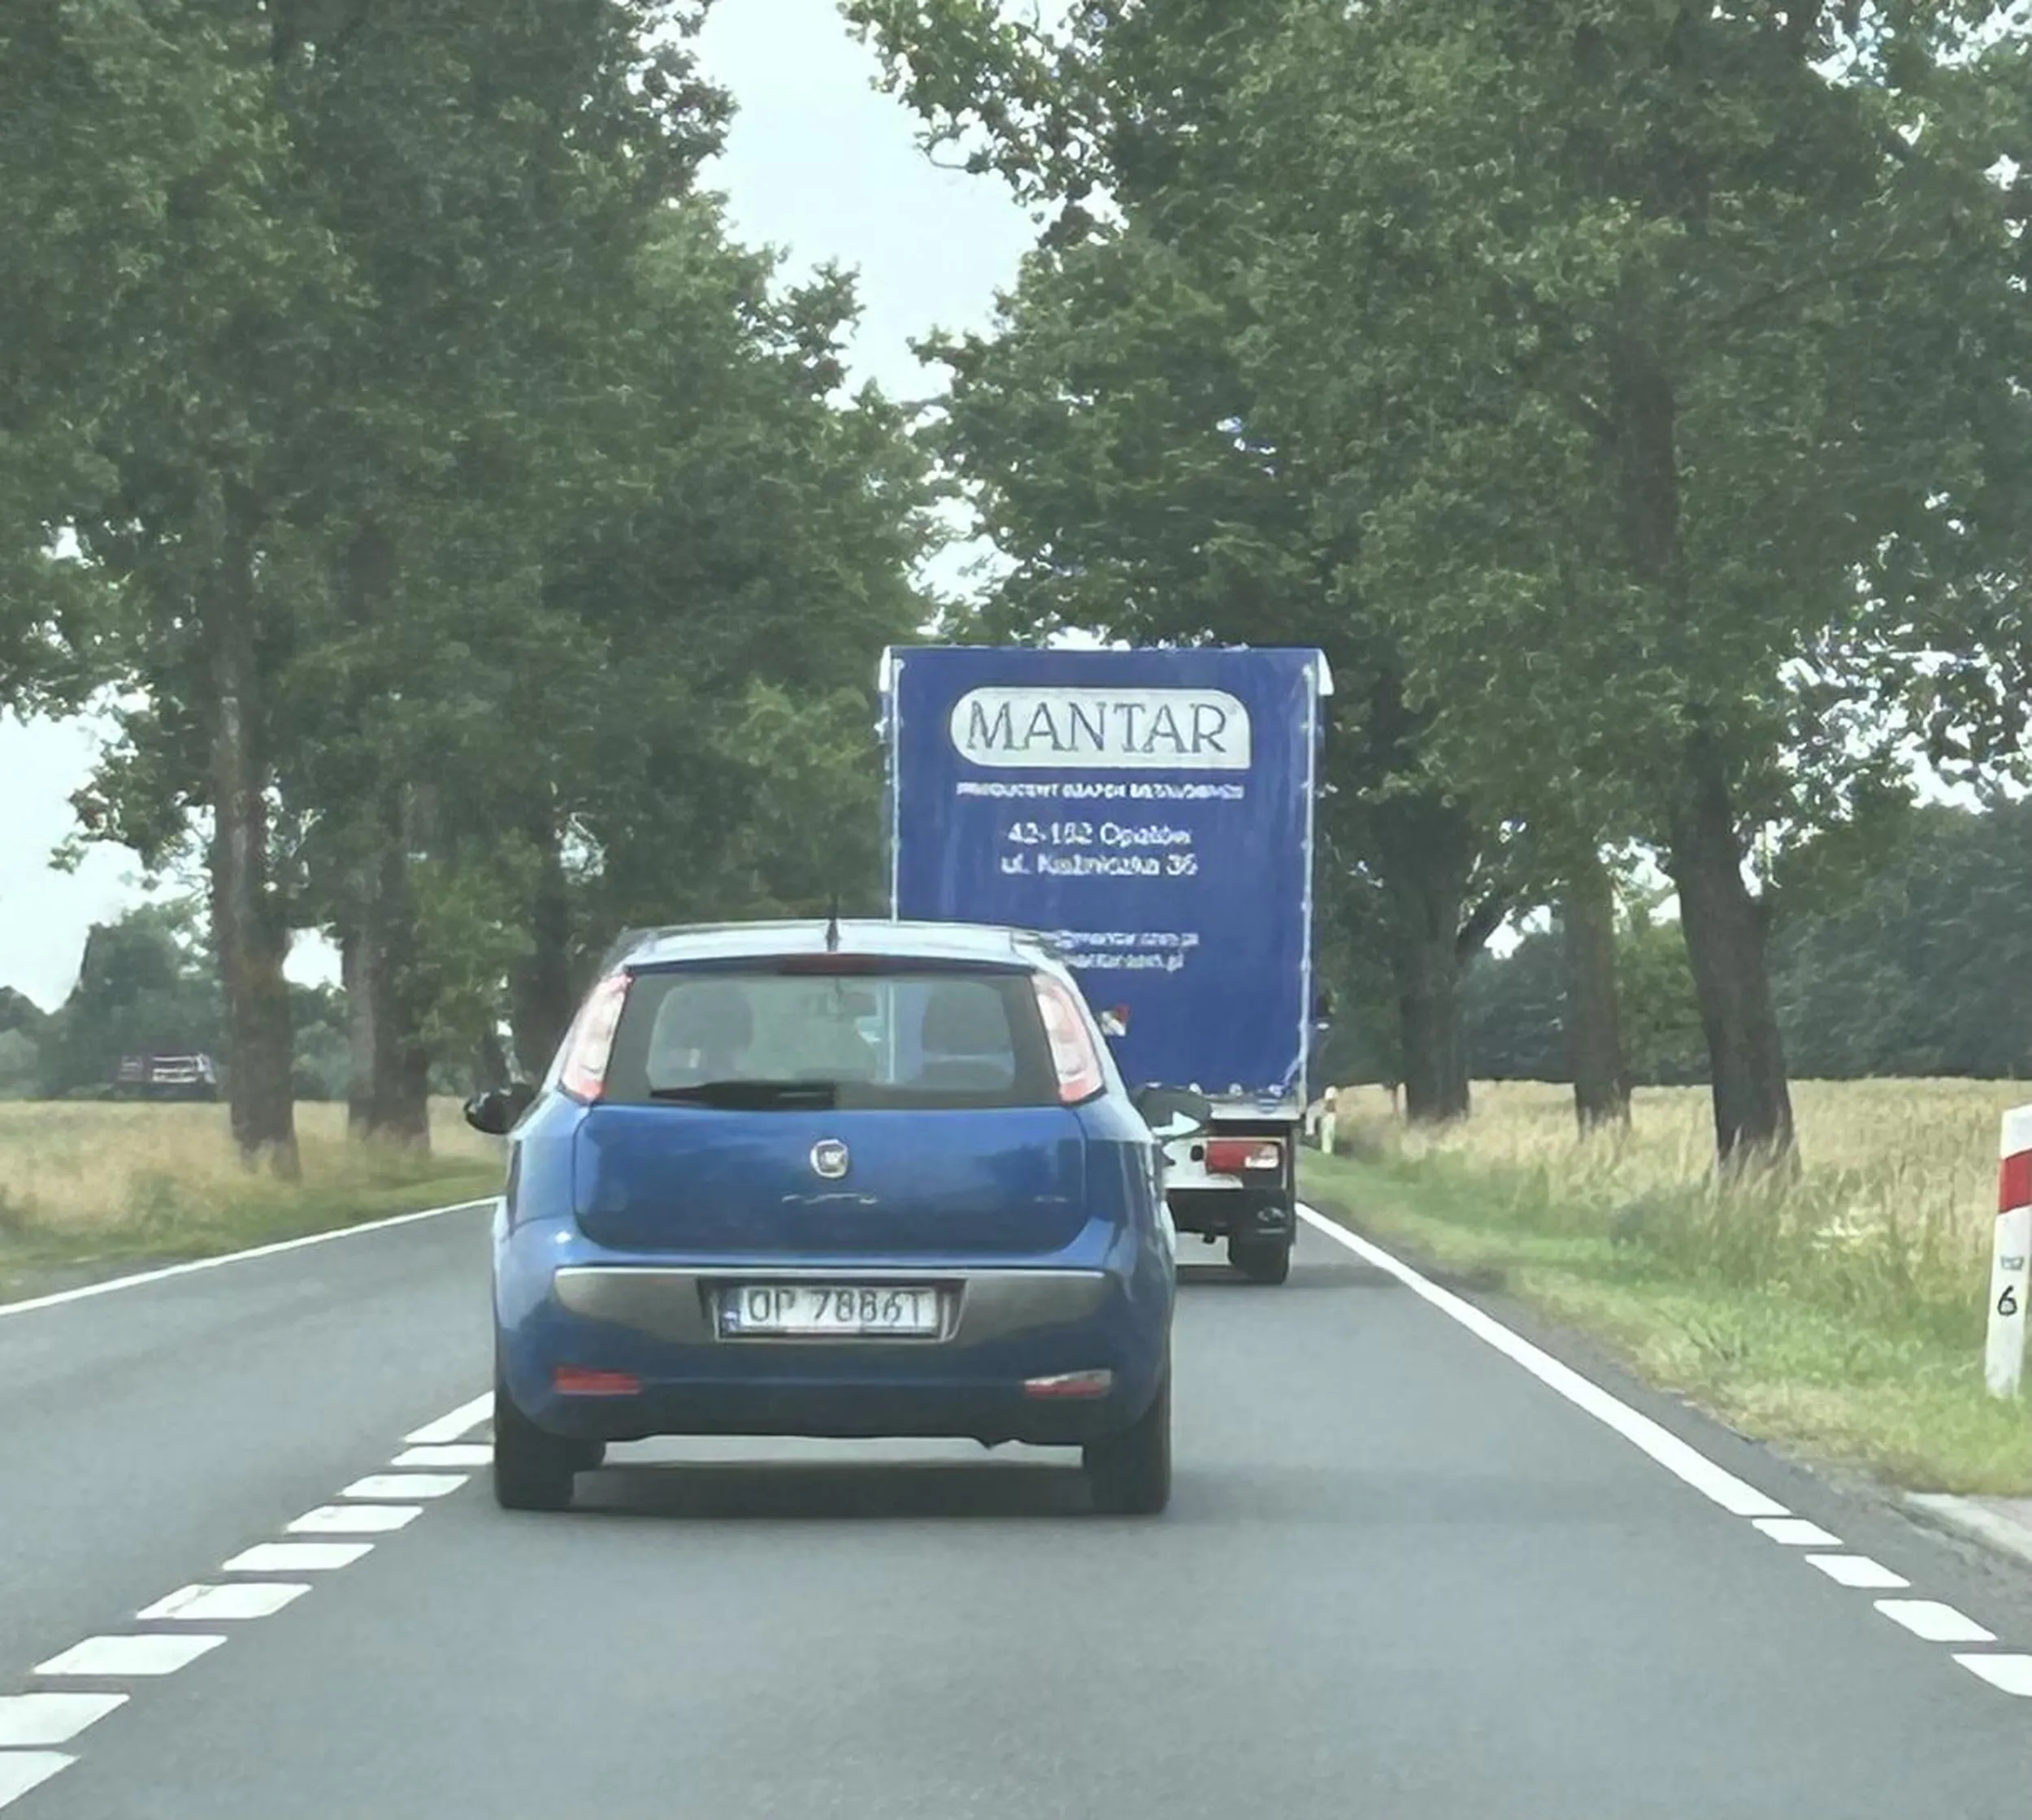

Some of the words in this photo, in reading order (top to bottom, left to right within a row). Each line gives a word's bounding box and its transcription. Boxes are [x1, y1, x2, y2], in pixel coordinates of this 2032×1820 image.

[966, 700, 1227, 754] MANTAR
[748, 1288, 797, 1323] OP
[1997, 1285, 2017, 1317] 6
